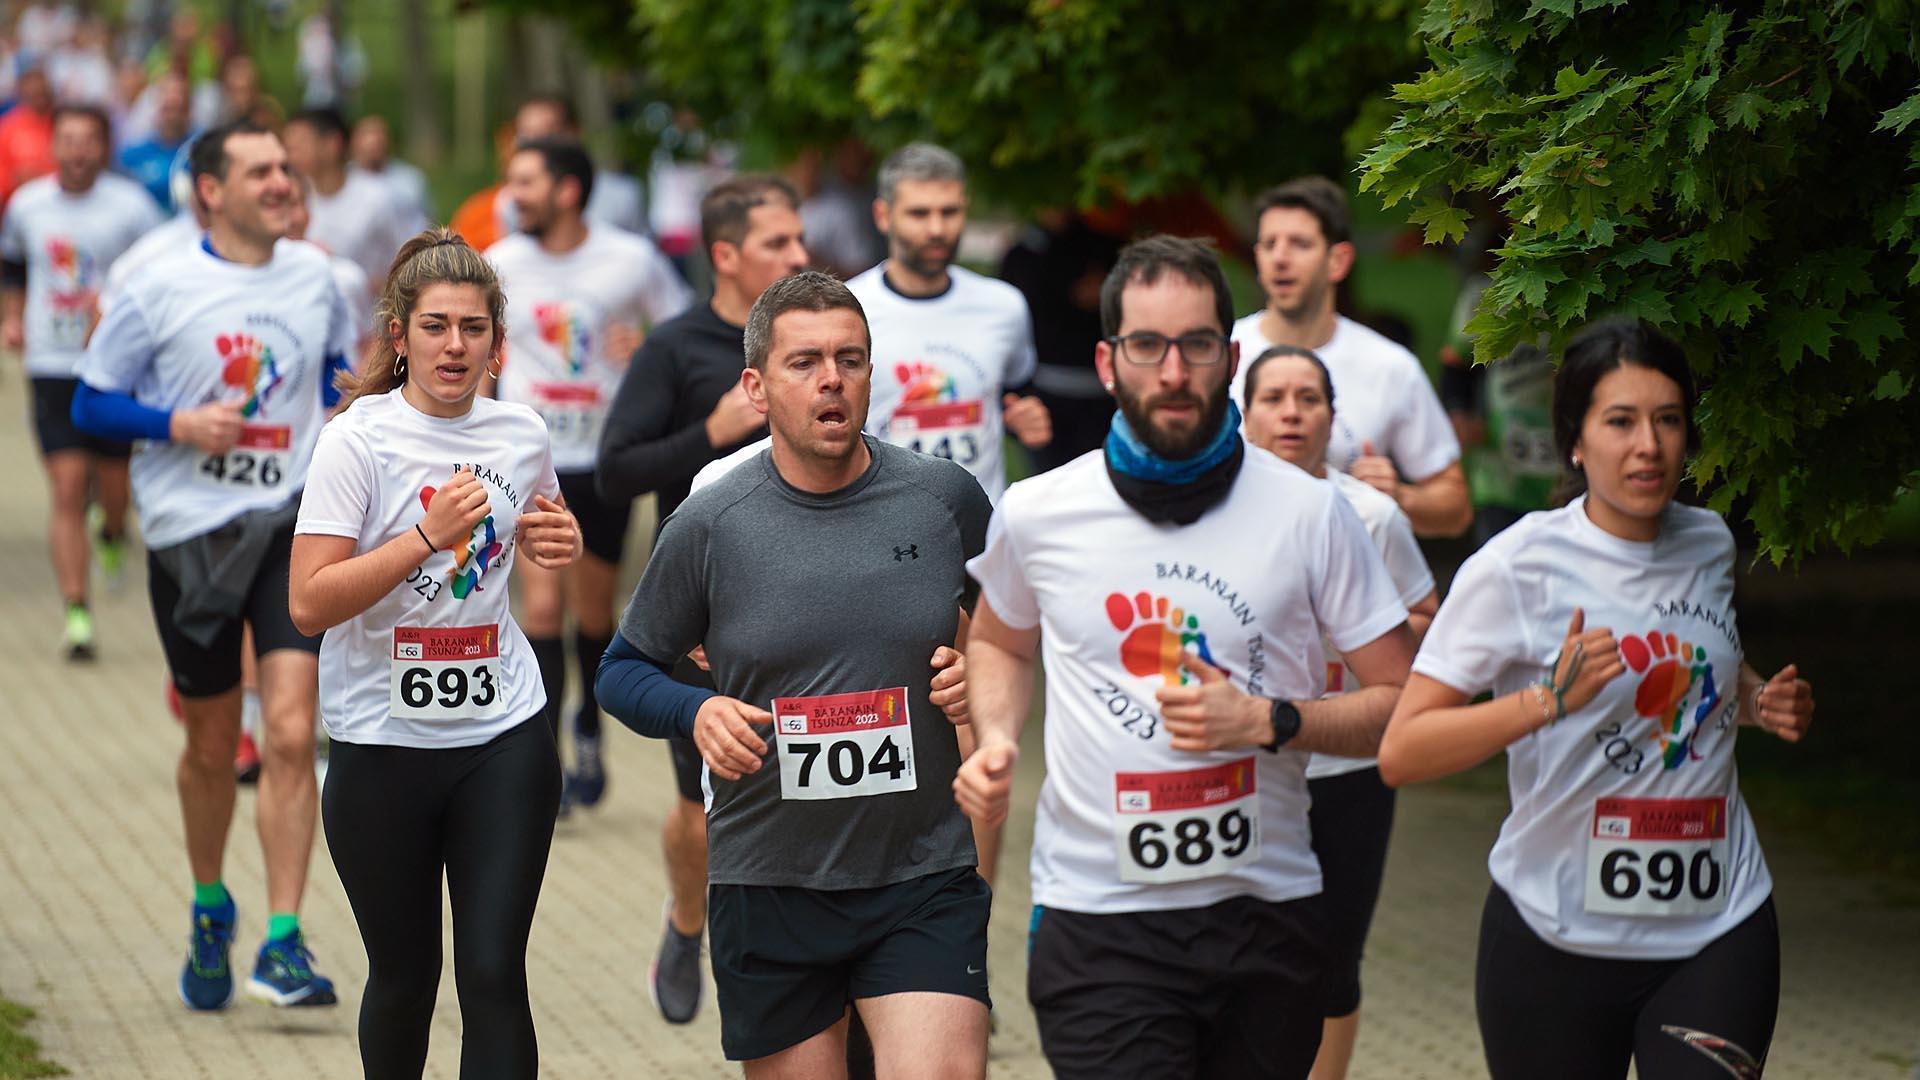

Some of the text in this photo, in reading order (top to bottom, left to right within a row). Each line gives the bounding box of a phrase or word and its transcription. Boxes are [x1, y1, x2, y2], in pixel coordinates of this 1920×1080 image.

[202, 453, 282, 488] 426
[911, 435, 978, 464] 43
[453, 463, 519, 509] BRAÑAIN
[405, 566, 442, 602] 023
[427, 646, 465, 656] TSUNZA
[401, 665, 496, 708] 693
[810, 713, 879, 729] TSUNZA 2023
[1093, 681, 1157, 740] 2023
[788, 735, 906, 788] 704
[1128, 808, 1250, 870] 689
[1600, 848, 1720, 901] 690
